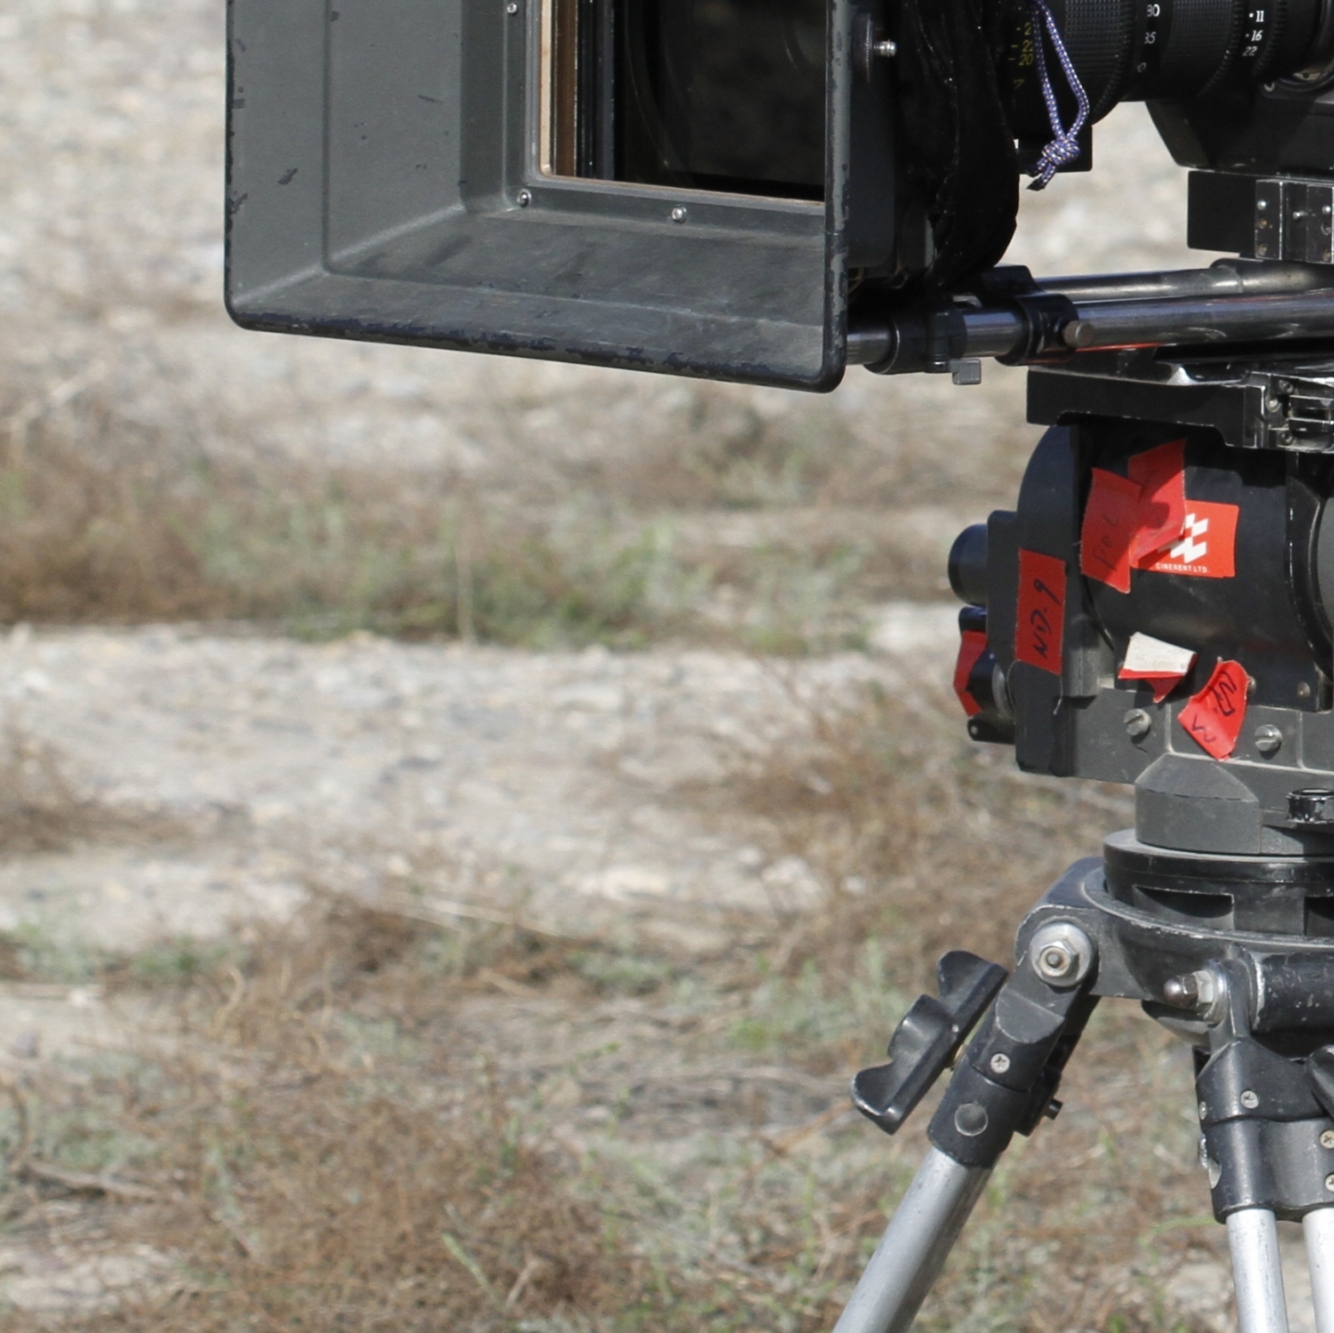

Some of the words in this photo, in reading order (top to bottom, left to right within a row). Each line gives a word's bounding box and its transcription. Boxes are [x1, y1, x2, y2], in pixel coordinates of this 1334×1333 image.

[1255, 10, 1265, 23] 11
[1251, 29, 1264, 41] 16
[1242, 45, 1258, 57] 22
[1155, 562, 1192, 572] CINERENT
